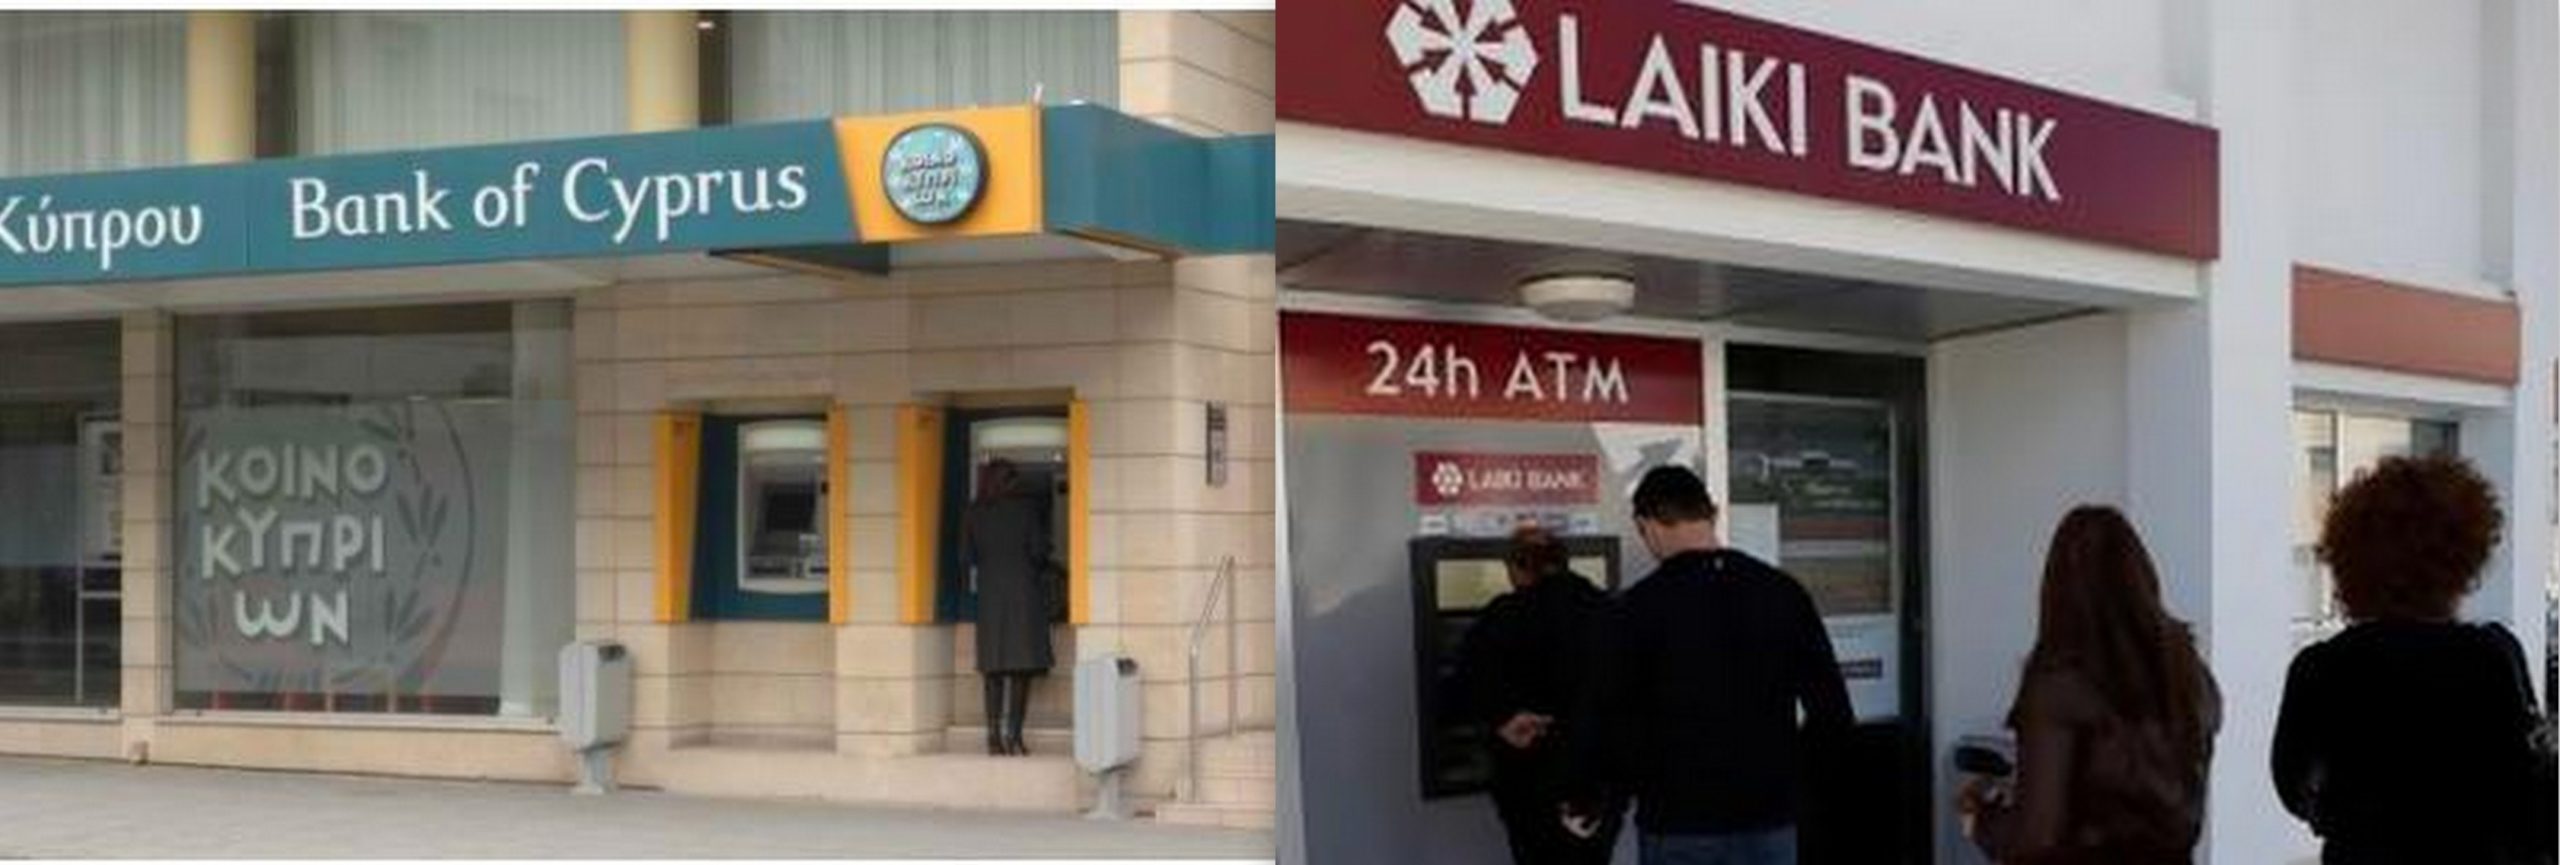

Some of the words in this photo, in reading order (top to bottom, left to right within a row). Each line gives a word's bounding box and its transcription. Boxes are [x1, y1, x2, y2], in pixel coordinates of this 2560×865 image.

[1559, 14, 1808, 157] LAIKI
[1846, 74, 2061, 202] BANK
[288, 170, 454, 239] Bank
[472, 162, 541, 229] of
[562, 157, 808, 244] Cyprus
[1365, 340, 1480, 397] 24h
[1504, 352, 1630, 404] ATM
[197, 443, 386, 508] ΚΟΙΝΟ
[201, 508, 385, 580] ΚΥΠΡΙ
